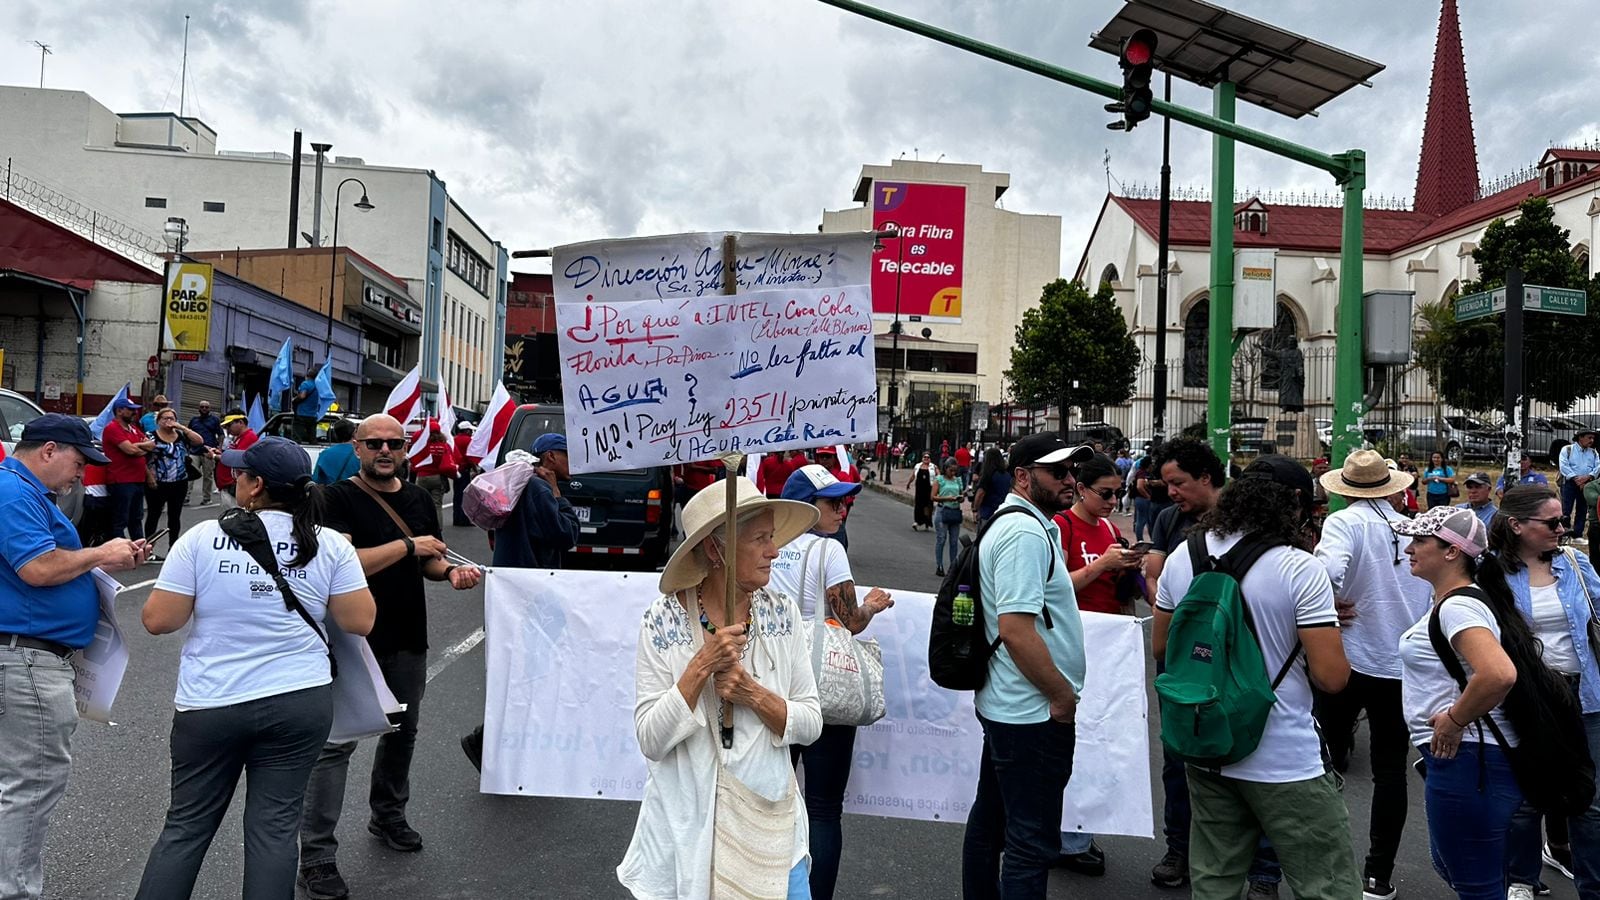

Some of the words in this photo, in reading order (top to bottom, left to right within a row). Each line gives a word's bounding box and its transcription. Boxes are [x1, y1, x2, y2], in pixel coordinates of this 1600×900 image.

[881, 187, 898, 205] T
[885, 222, 916, 238] Pra
[919, 225, 954, 239] Fibra
[910, 244, 926, 255] es
[564, 254, 688, 288] Dirección
[879, 259, 955, 275] Telecable
[171, 289, 197, 300] PAR
[1548, 295, 1569, 305] CALLE
[1570, 298, 1578, 306] 12
[169, 301, 208, 313] QUEO
[942, 295, 958, 312] T
[1458, 299, 1484, 313] AVENIDA
[1484, 298, 1489, 308] 2
[566, 294, 635, 342] ¿Por
[642, 300, 692, 345] qué
[785, 300, 817, 320] Coca
[817, 292, 860, 320] Cola,
[764, 344, 796, 370] les
[796, 338, 842, 378] falta
[846, 336, 866, 358] el
[662, 439, 684, 462] el
[688, 436, 742, 462] AGUA
[743, 436, 764, 448] en
[763, 423, 800, 444] Costa
[219, 560, 240, 574] En
[246, 562, 260, 575] la
